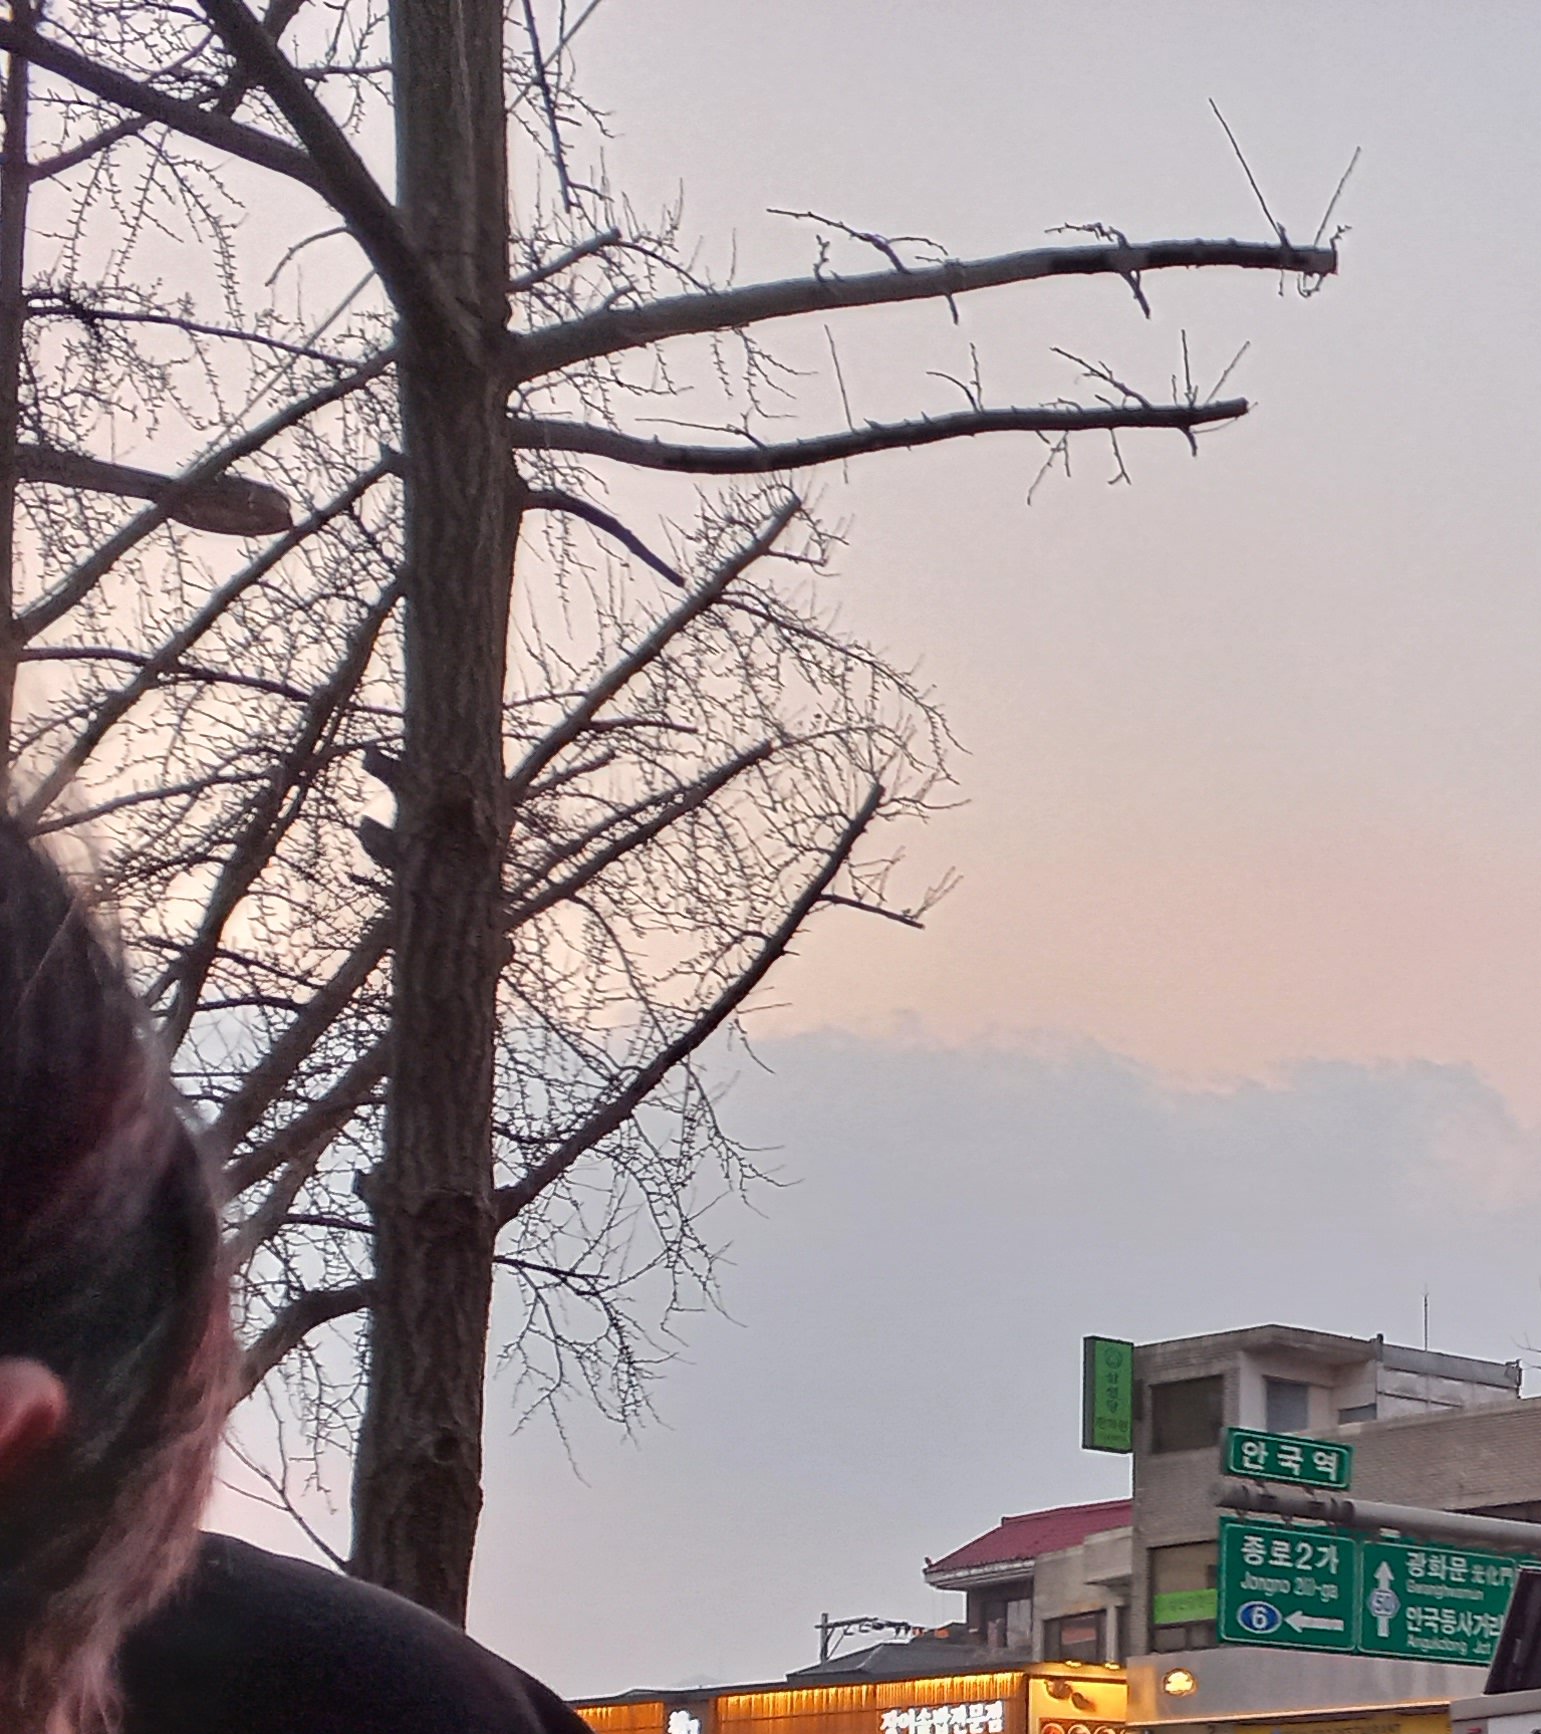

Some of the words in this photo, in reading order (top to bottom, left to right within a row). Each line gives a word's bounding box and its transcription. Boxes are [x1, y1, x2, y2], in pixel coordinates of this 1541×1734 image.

[1241, 1440, 1340, 1482] 안국역
[1240, 1535, 1340, 1574] 종로2가
[1405, 1551, 1468, 1583] 광화문
[1240, 1571, 1291, 1597] Jongno
[1251, 1605, 1268, 1630] 6
[1406, 1607, 1506, 1638] 안국동사거리
